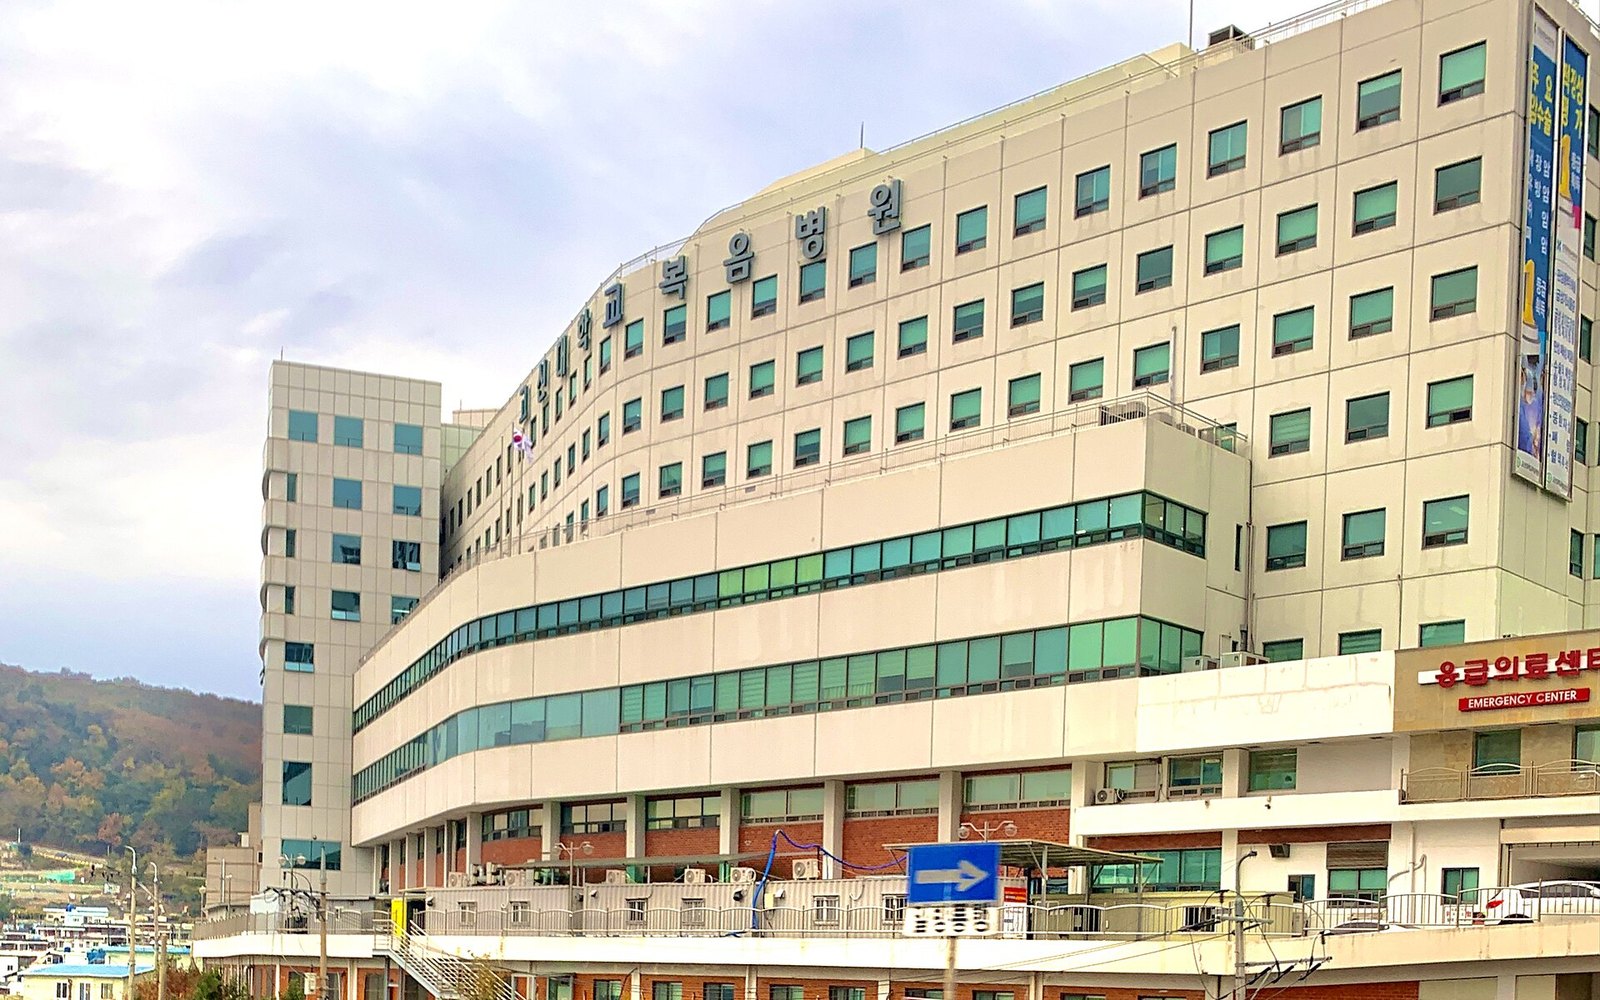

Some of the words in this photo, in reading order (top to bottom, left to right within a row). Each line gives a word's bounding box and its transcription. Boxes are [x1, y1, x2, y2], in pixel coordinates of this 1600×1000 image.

[659, 179, 903, 299] 복음병원
[1468, 693, 1533, 709] EMERGENCY
[1536, 690, 1577, 703] CENTER
